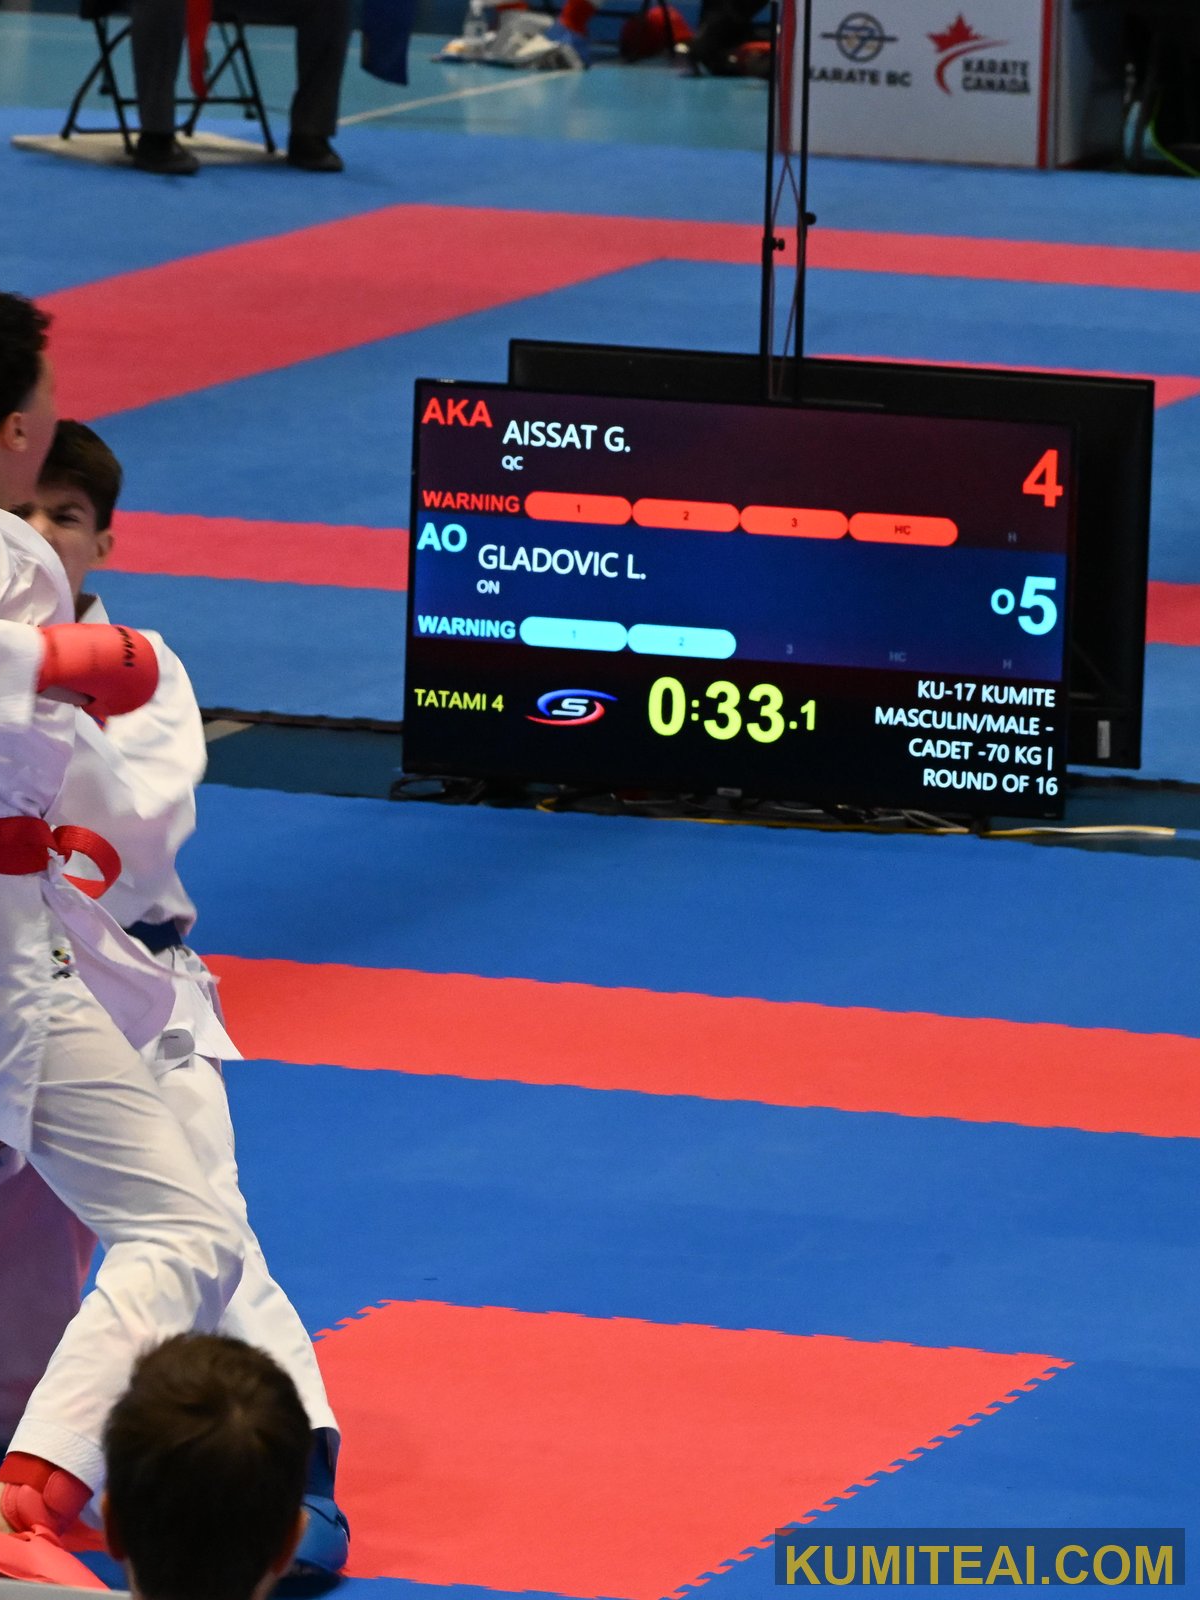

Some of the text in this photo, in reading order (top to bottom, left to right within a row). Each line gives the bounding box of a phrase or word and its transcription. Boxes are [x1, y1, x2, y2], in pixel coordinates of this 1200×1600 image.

[421, 397, 494, 428] AKA
[502, 419, 632, 453] AISSAT G.
[501, 454, 524, 472] QC
[1021, 448, 1064, 508] 4
[422, 489, 521, 514] WARNING
[682, 510, 690, 521] 2
[416, 521, 468, 553] AO
[790, 517, 798, 528] 3
[477, 543, 647, 581] GLADOVIC L.
[475, 579, 501, 595] ON
[417, 614, 516, 640] WARNING
[413, 688, 505, 713] TATAMI 4
[917, 679, 1056, 708] KU-17 KUMITE
[648, 676, 817, 744] 0:33.1
[874, 706, 1039, 736] MASCULIN/MALE
[908, 737, 973, 761] CADET
[977, 742, 1010, 764] -70
[1014, 746, 1042, 767] KG
[922, 767, 1059, 796] ROUND OF 16
